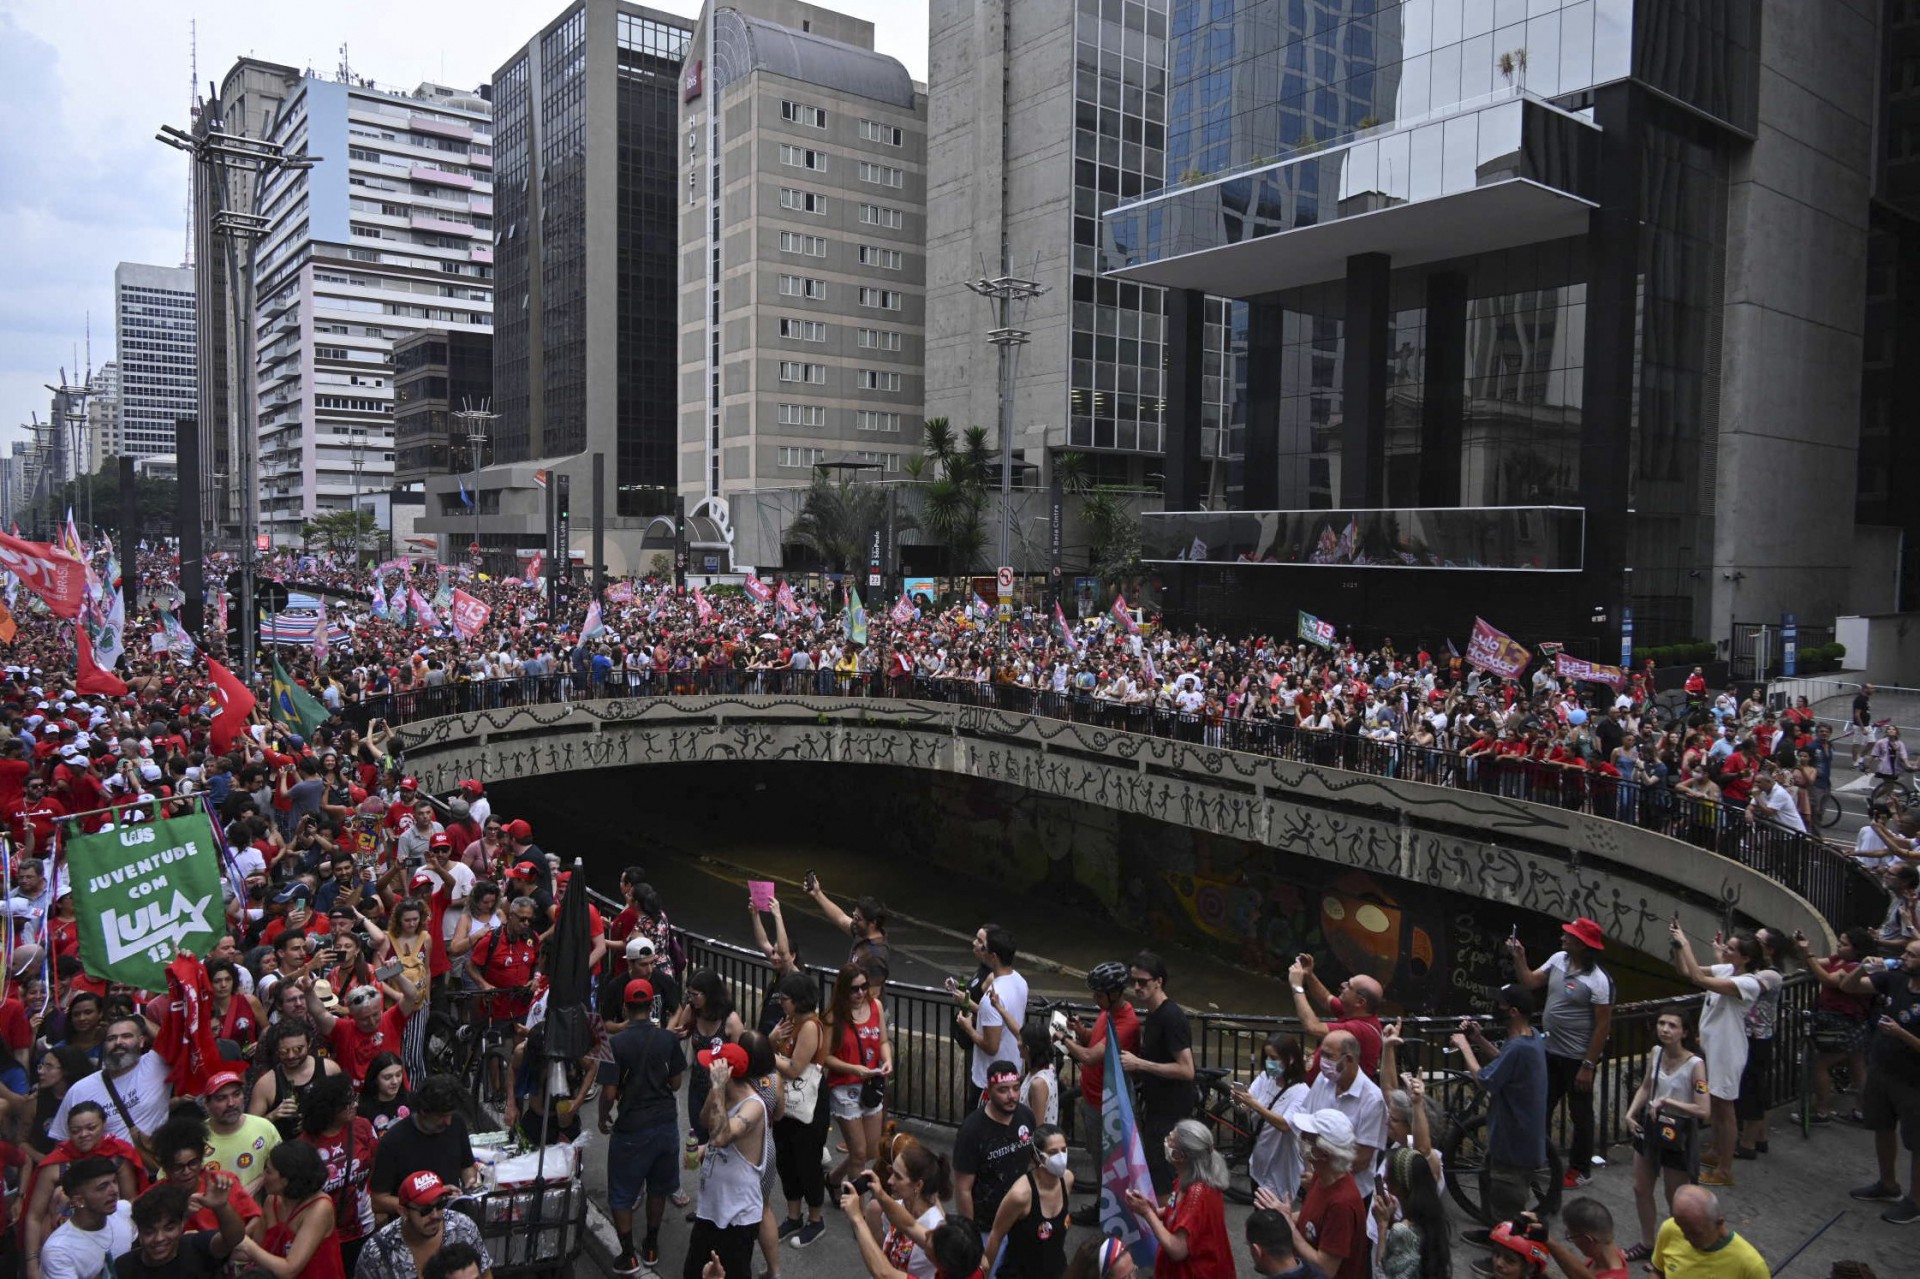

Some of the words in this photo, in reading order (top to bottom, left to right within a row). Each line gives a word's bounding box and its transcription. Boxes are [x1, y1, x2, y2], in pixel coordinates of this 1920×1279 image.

[686, 76, 697, 91] ibis
[688, 114, 696, 206] HOTEL
[465, 601, 486, 621] 13
[1317, 620, 1333, 639] 13
[1465, 641, 1518, 673] Haddad
[1472, 628, 1500, 651] Lula
[1496, 636, 1528, 668] 13
[89, 841, 198, 893] JUVENTUDE
[128, 875, 169, 899] COM
[100, 888, 213, 965] LULA
[147, 941, 172, 963] 13
[998, 1072, 1018, 1082] Lula
[987, 1145, 1010, 1160] JOHN
[413, 1171, 440, 1191] LULA
